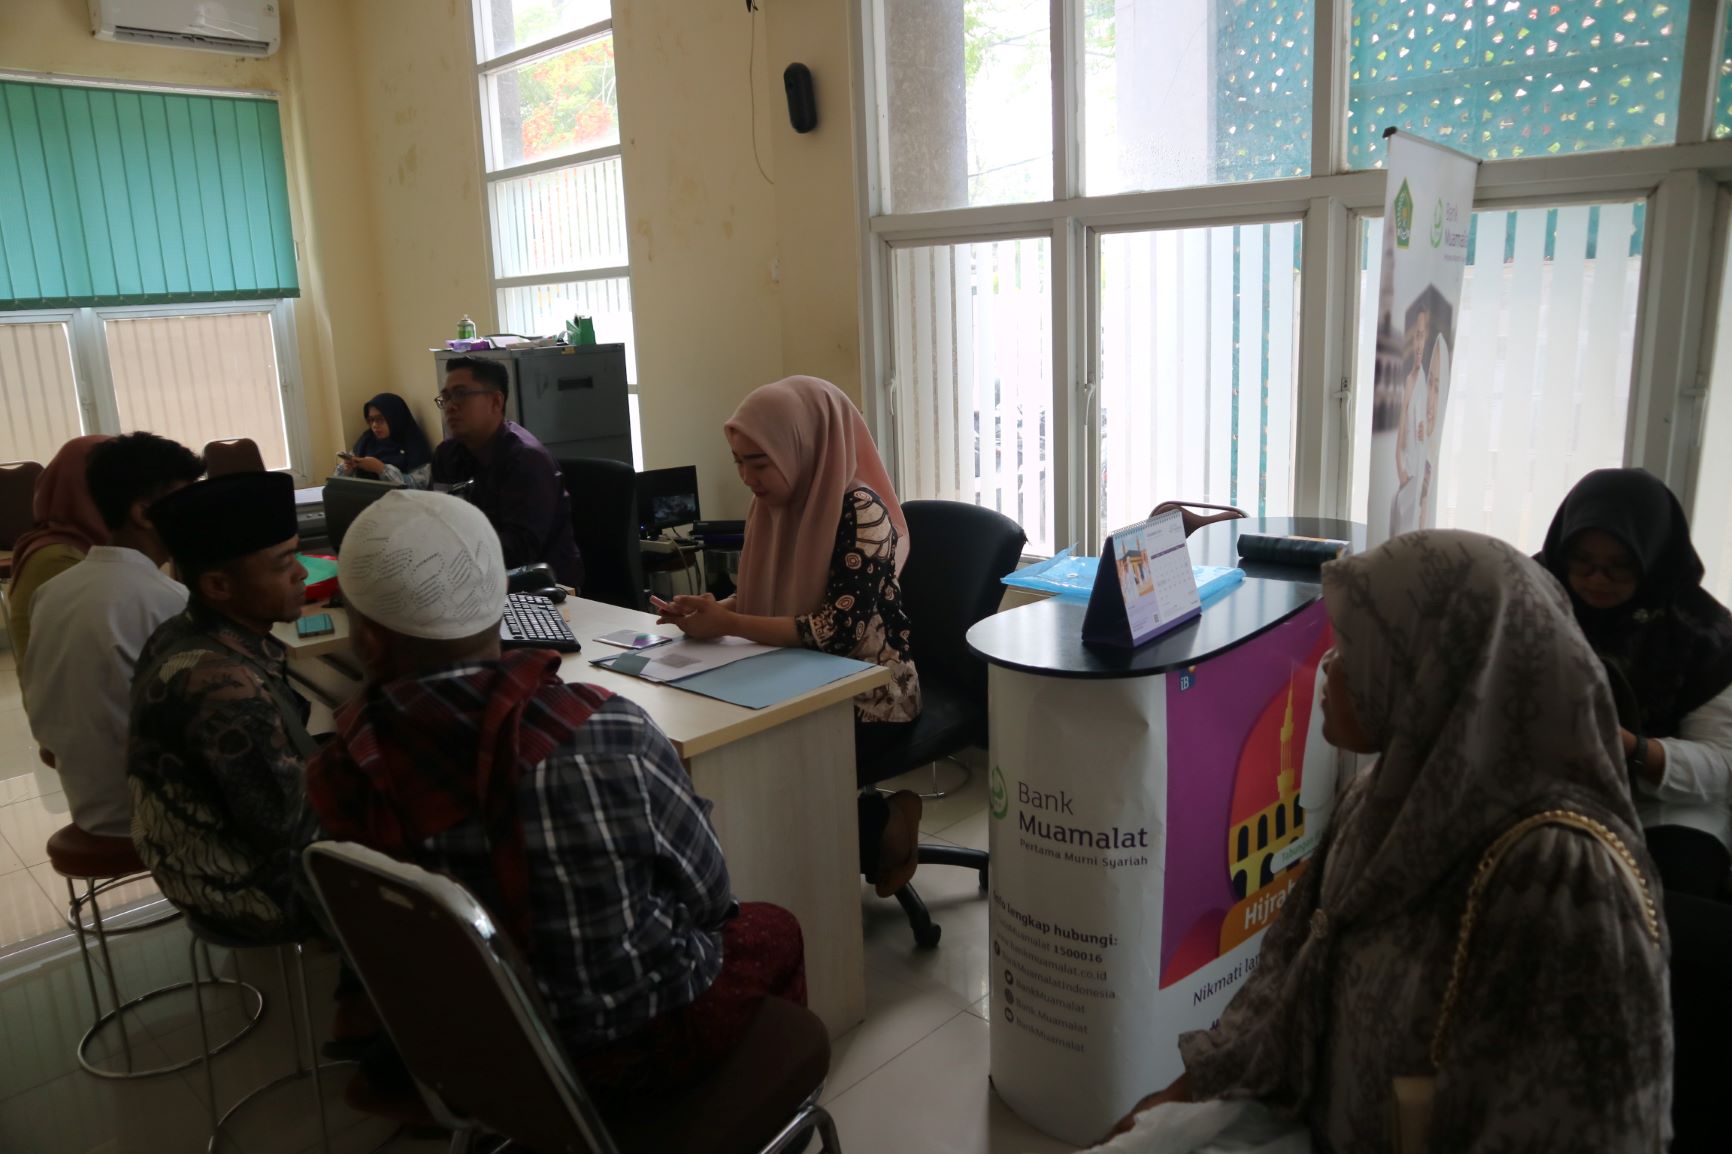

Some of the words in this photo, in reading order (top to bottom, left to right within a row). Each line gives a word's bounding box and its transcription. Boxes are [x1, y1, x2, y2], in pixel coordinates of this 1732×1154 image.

[1018, 781, 1073, 815] Bank
[1019, 810, 1148, 849] Muamalat
[1020, 838, 1061, 859] Pertama
[1065, 853, 1098, 866] Murni
[1102, 856, 1148, 869] Syariah
[1007, 903, 1050, 934] lengkap
[1054, 923, 1118, 948] hubungi:
[1054, 945, 1103, 963] 1500016
[1193, 963, 1242, 1006] Nikmati
